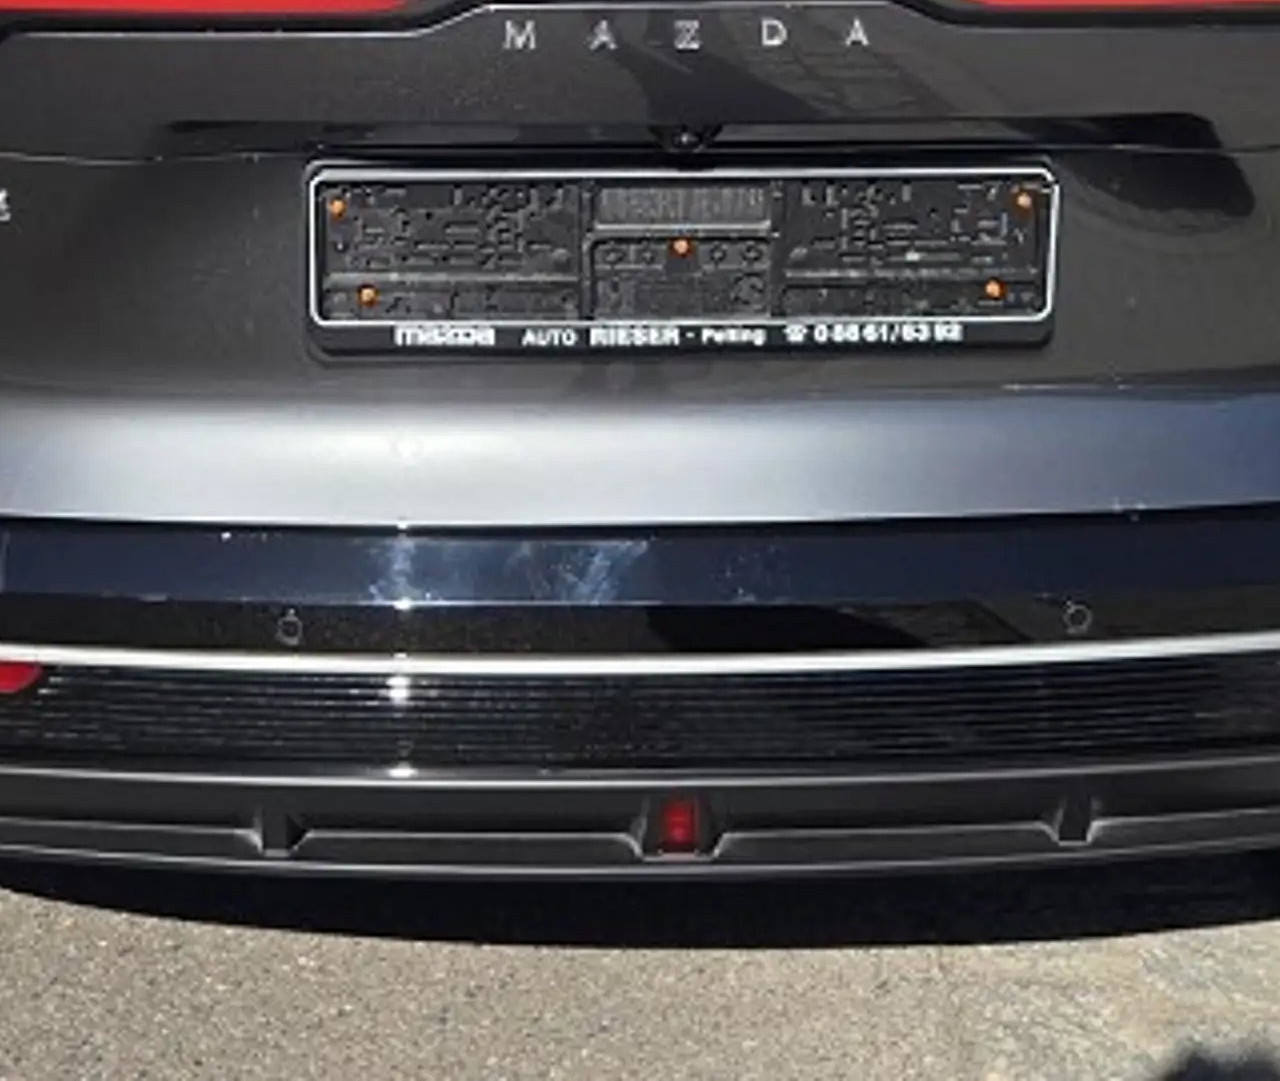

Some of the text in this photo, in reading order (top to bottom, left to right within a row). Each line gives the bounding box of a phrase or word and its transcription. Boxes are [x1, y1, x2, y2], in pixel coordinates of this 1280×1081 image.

[502, 18, 869, 51] MAZDA
[521, 327, 579, 346] AUTO
[589, 326, 680, 347] RIESER
